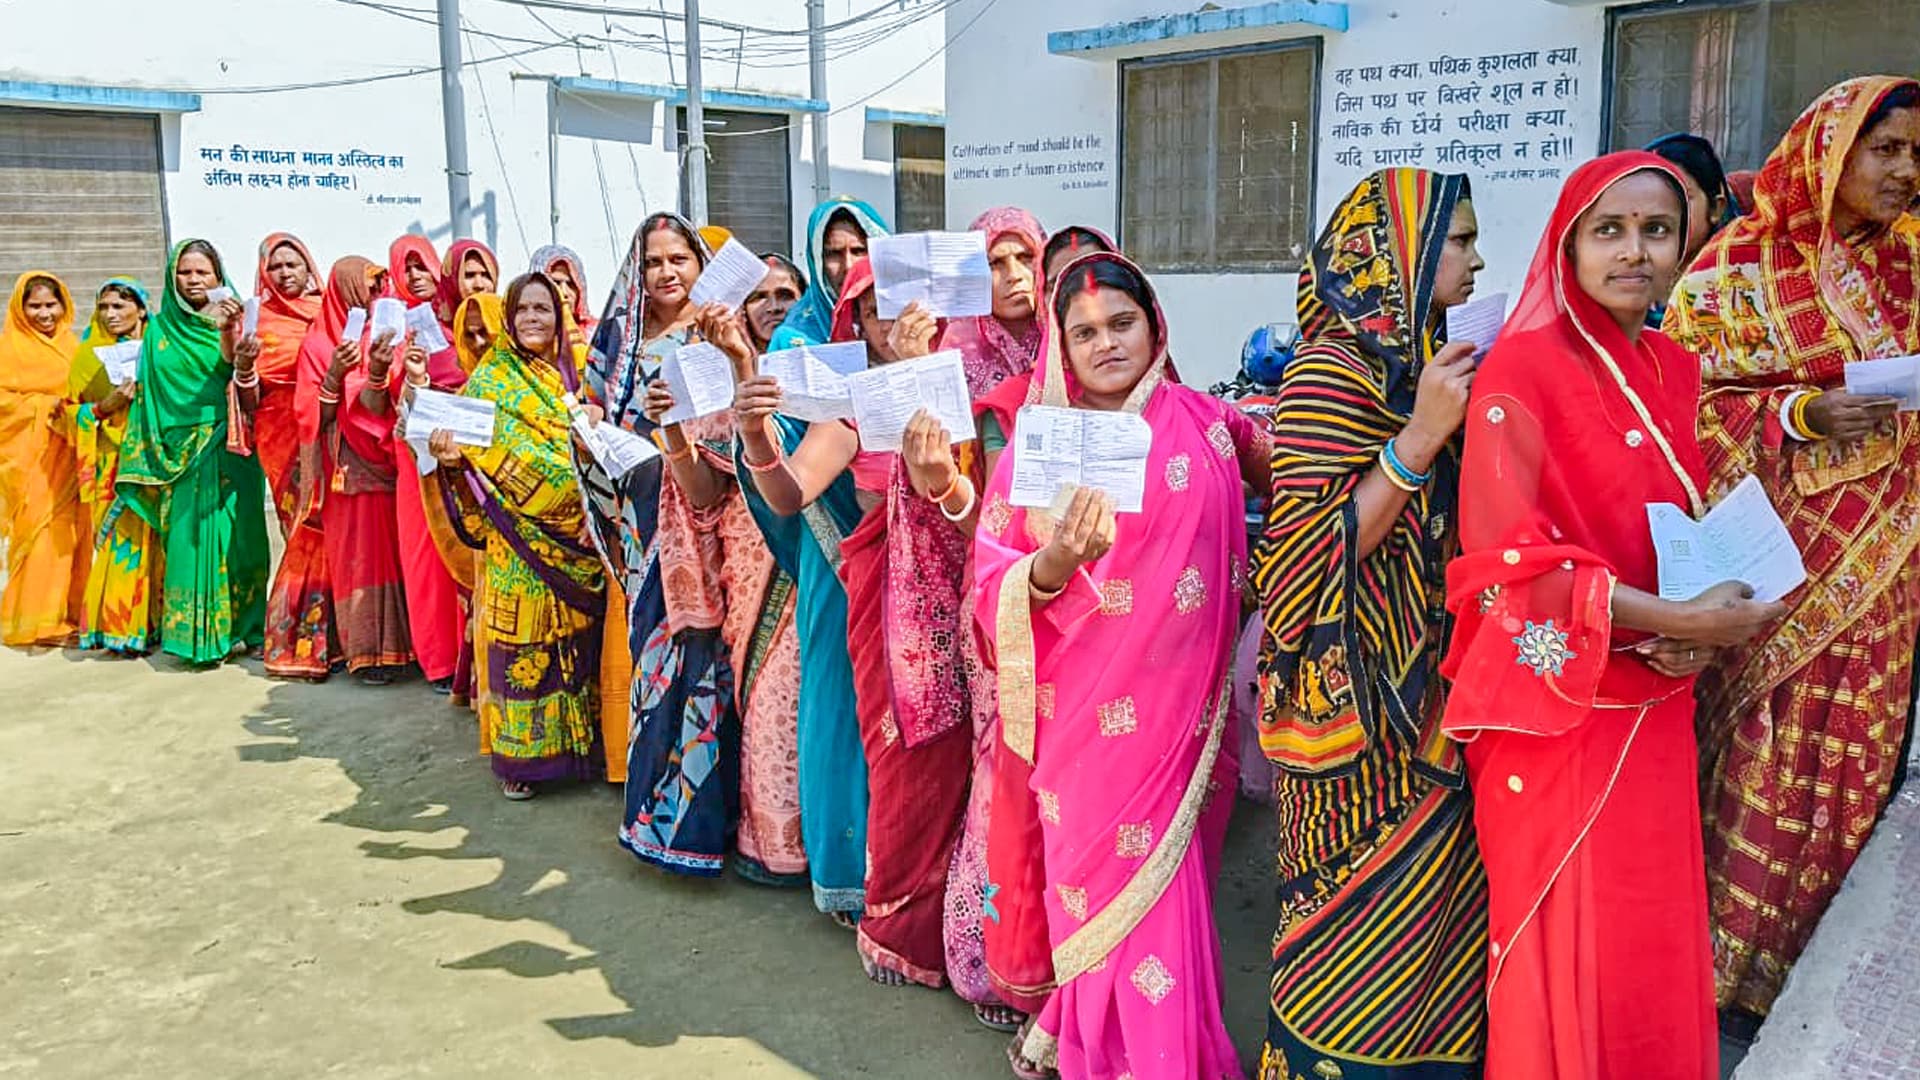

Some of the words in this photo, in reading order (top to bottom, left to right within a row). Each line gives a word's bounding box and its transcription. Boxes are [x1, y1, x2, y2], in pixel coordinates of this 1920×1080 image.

[1335, 68, 1354, 88] वह
[1358, 66, 1382, 81] पथ
[1429, 55, 1473, 76] पथिक
[1477, 51, 1540, 78] कुशलता
[1335, 91, 1363, 112] जिस
[1371, 93, 1398, 110] पथ
[1405, 91, 1427, 107] पर
[1490, 82, 1523, 106] शूल
[1531, 80, 1548, 97] न
[1332, 119, 1374, 139] नाविक
[1379, 116, 1402, 136] की
[1458, 109, 1511, 133] परीक्षा
[200, 148, 224, 162] मन
[229, 144, 250, 163] की
[251, 150, 296, 164] साधना
[337, 149, 385, 169] अस्तित्व
[386, 155, 406, 168] का
[1003, 140, 1014, 154] of
[1017, 137, 1039, 152] mind
[1040, 135, 1070, 151] should
[1072, 135, 1083, 149] be
[1086, 133, 1101, 149] the
[1335, 146, 1364, 167] यदि
[1435, 139, 1502, 168] प्रतिकूल
[1513, 141, 1530, 158] न
[203, 168, 242, 186] अंतिम
[247, 173, 283, 188] लक्ष्य
[288, 170, 311, 189] होना
[1024, 162, 1055, 176] human
